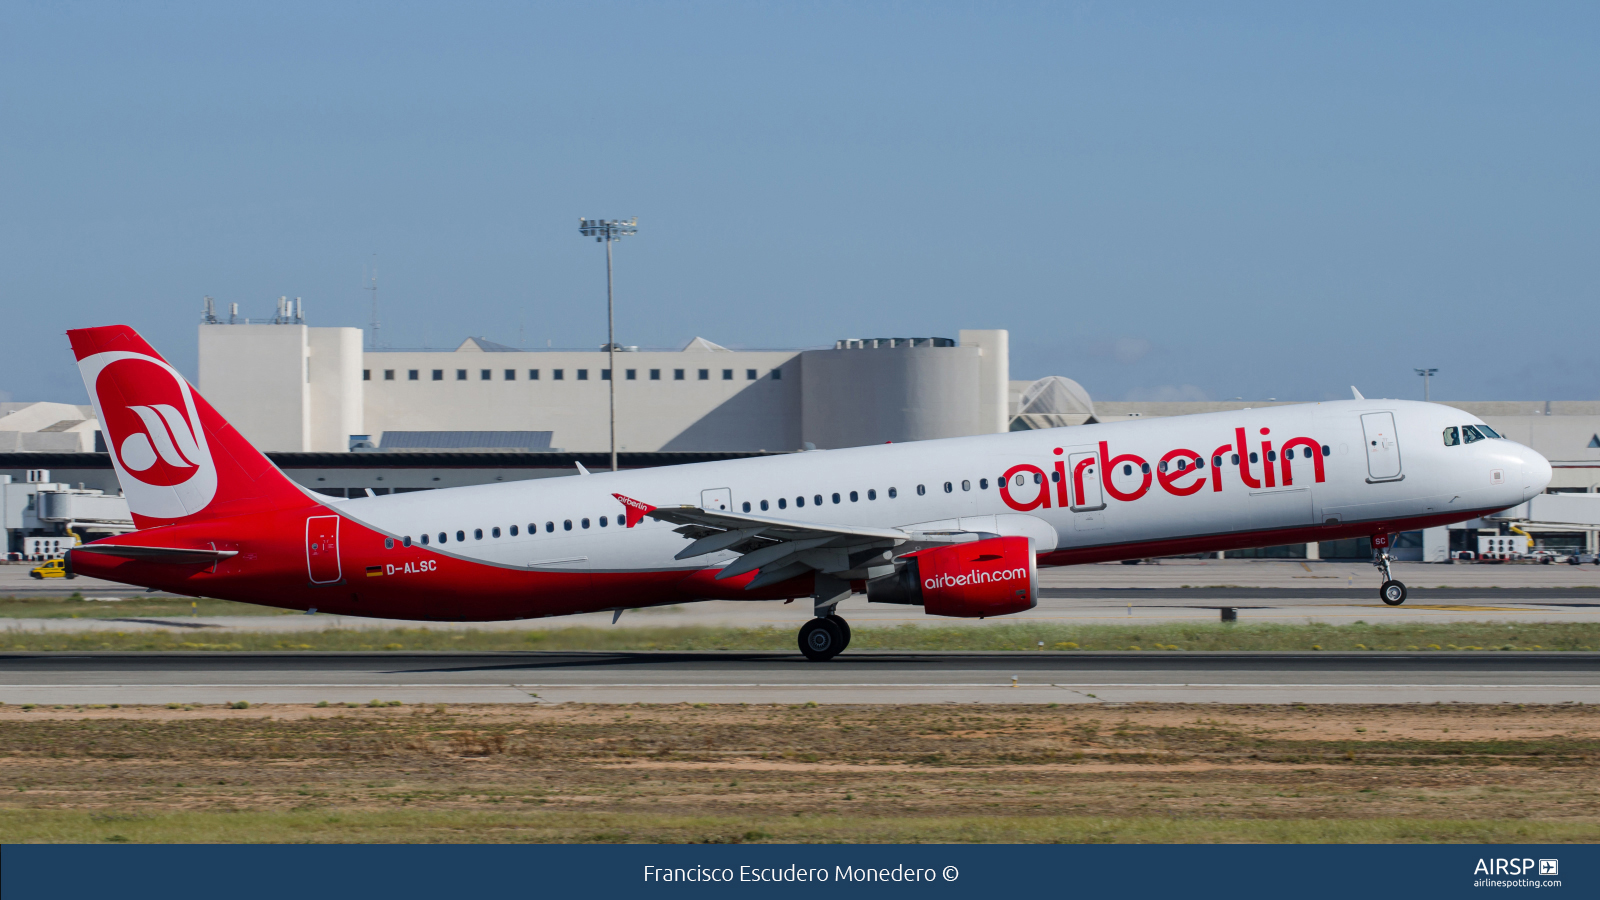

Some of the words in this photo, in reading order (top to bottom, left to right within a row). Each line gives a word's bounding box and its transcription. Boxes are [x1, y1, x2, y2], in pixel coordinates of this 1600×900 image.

[999, 427, 1326, 512] airberlin
[617, 496, 648, 511] airberlin
[1375, 537, 1386, 545] SC
[386, 559, 437, 576] D-ALSC
[924, 567, 1027, 590] airberlin.com
